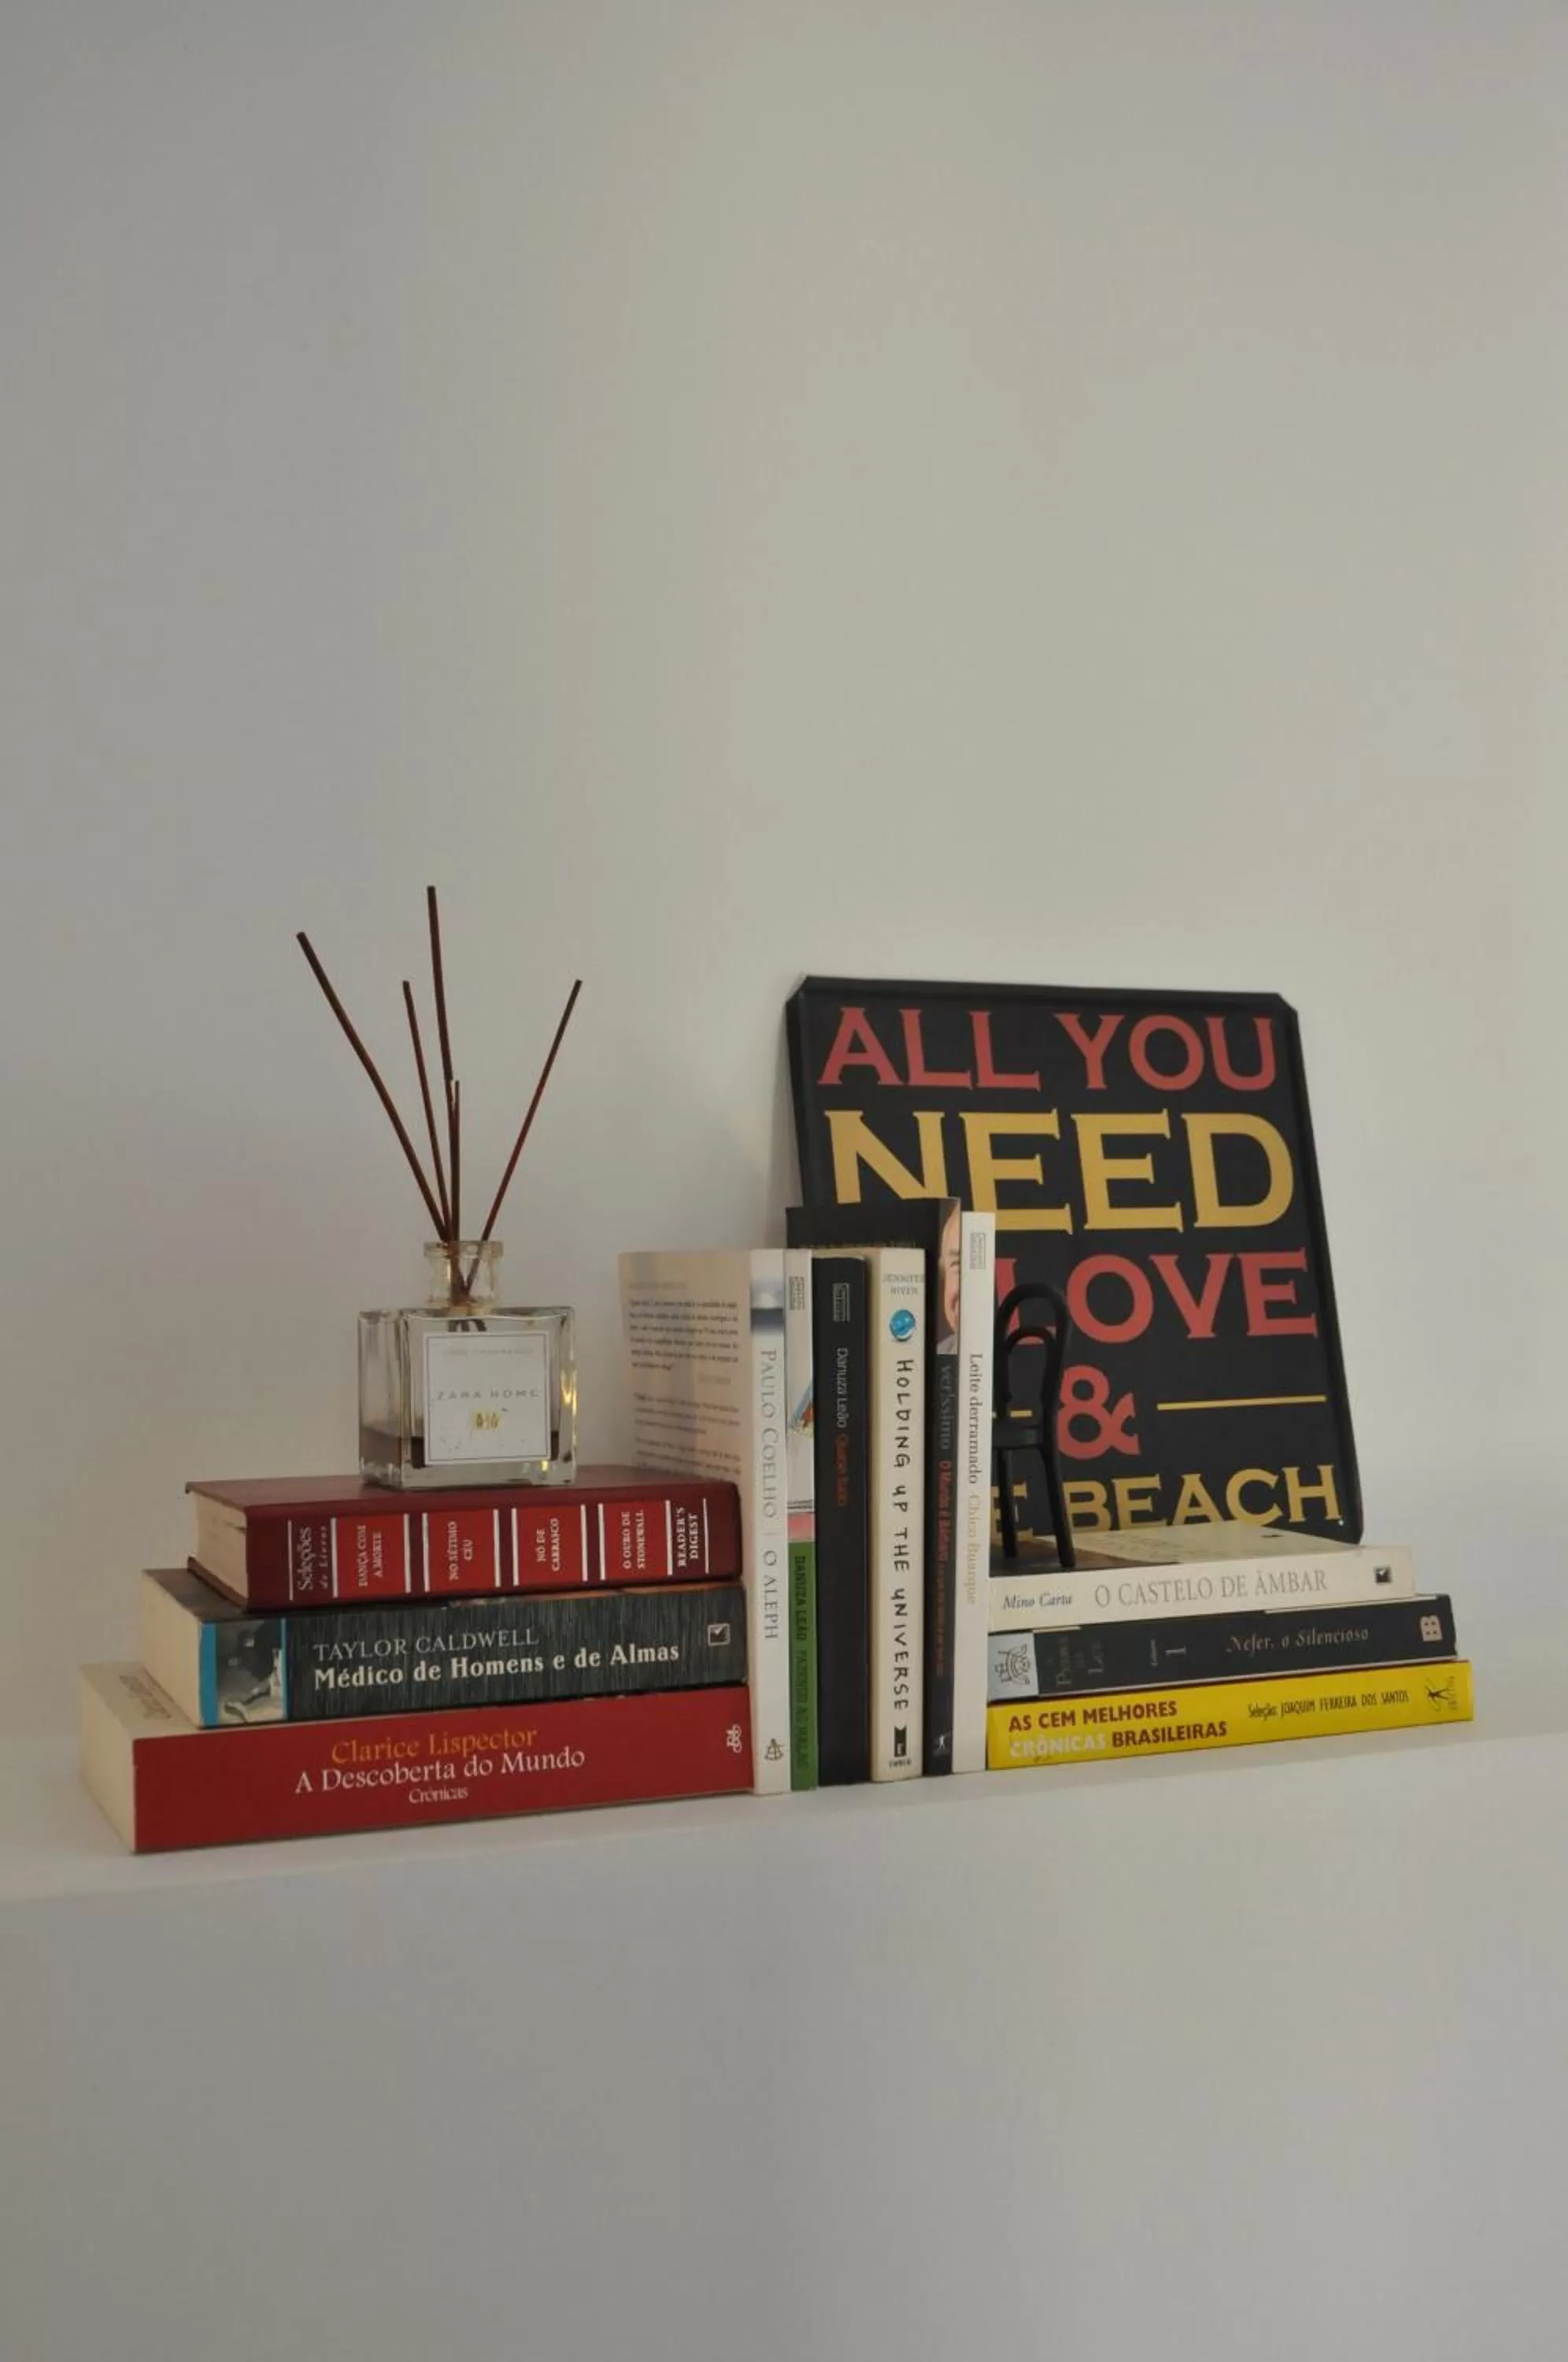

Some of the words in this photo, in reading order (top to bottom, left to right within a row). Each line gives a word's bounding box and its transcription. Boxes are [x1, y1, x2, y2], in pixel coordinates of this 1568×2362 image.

[818, 1007, 1041, 1091] ALL
[1054, 1013, 1278, 1091] YOU
[824, 1108, 1295, 1235] NEED
[760, 1349, 778, 1418] PAULO
[836, 1348, 849, 1394] Danuza
[969, 1353, 982, 1392] Leite
[436, 1390, 482, 1401] ZARA
[490, 1388, 539, 1399] HOME
[836, 1398, 849, 1427] Leão
[893, 1359, 913, 1468] HOLDING
[1056, 1364, 1141, 1460] &
[968, 1396, 982, 1484] derramado
[761, 1427, 779, 1519] COELHO
[622, 1511, 631, 1527] DE
[1061, 1464, 1342, 1531] BEACH
[357, 1525, 368, 1550] COM
[537, 1528, 545, 1543] DE
[550, 1518, 561, 1572] CARRASCO
[623, 1529, 631, 1559] OURO
[636, 1509, 646, 1570] STONEWALL
[676, 1506, 687, 1568] READER'S
[689, 1512, 699, 1560] DIGEST
[763, 1549, 777, 1567] O
[893, 1527, 909, 1572] THE
[297, 1527, 315, 1590] Seleções
[357, 1553, 368, 1587] DANÇA
[764, 1575, 778, 1639] ALEPH
[1002, 1594, 1036, 1609] Mino
[1039, 1593, 1073, 1607] Carta
[1094, 1584, 1111, 1608] O
[1118, 1576, 1214, 1607] CASTELO
[1221, 1574, 1247, 1598] DE
[1255, 1568, 1329, 1595] ÂMBAR
[313, 1638, 408, 1662] TAYLOR
[416, 1627, 540, 1654] CALDWELL
[1295, 1627, 1370, 1647] Silencioso
[313, 1664, 404, 1690] Médico
[413, 1659, 441, 1681] de
[450, 1654, 544, 1679] Homens
[553, 1654, 565, 1671] e
[574, 1647, 601, 1668] de
[609, 1643, 680, 1666] Almas
[1008, 1715, 1032, 1732] AS
[1038, 1710, 1076, 1728] CEM
[1082, 1701, 1178, 1725] MELHORES
[1281, 1698, 1315, 1719] JOAQUIM
[1319, 1694, 1357, 1712] FERREIRA
[1361, 1692, 1377, 1706] DOS
[1381, 1690, 1410, 1704] SANTOS
[331, 1734, 420, 1764] Clarice
[429, 1727, 538, 1760] Lispector
[1009, 1733, 1107, 1759] CRÔNICAS
[1111, 1721, 1228, 1748] BRASILEIRAS
[294, 1772, 313, 1794] A
[321, 1760, 457, 1791] Descoberta
[464, 1753, 494, 1777] do
[501, 1746, 586, 1774] Mundo
